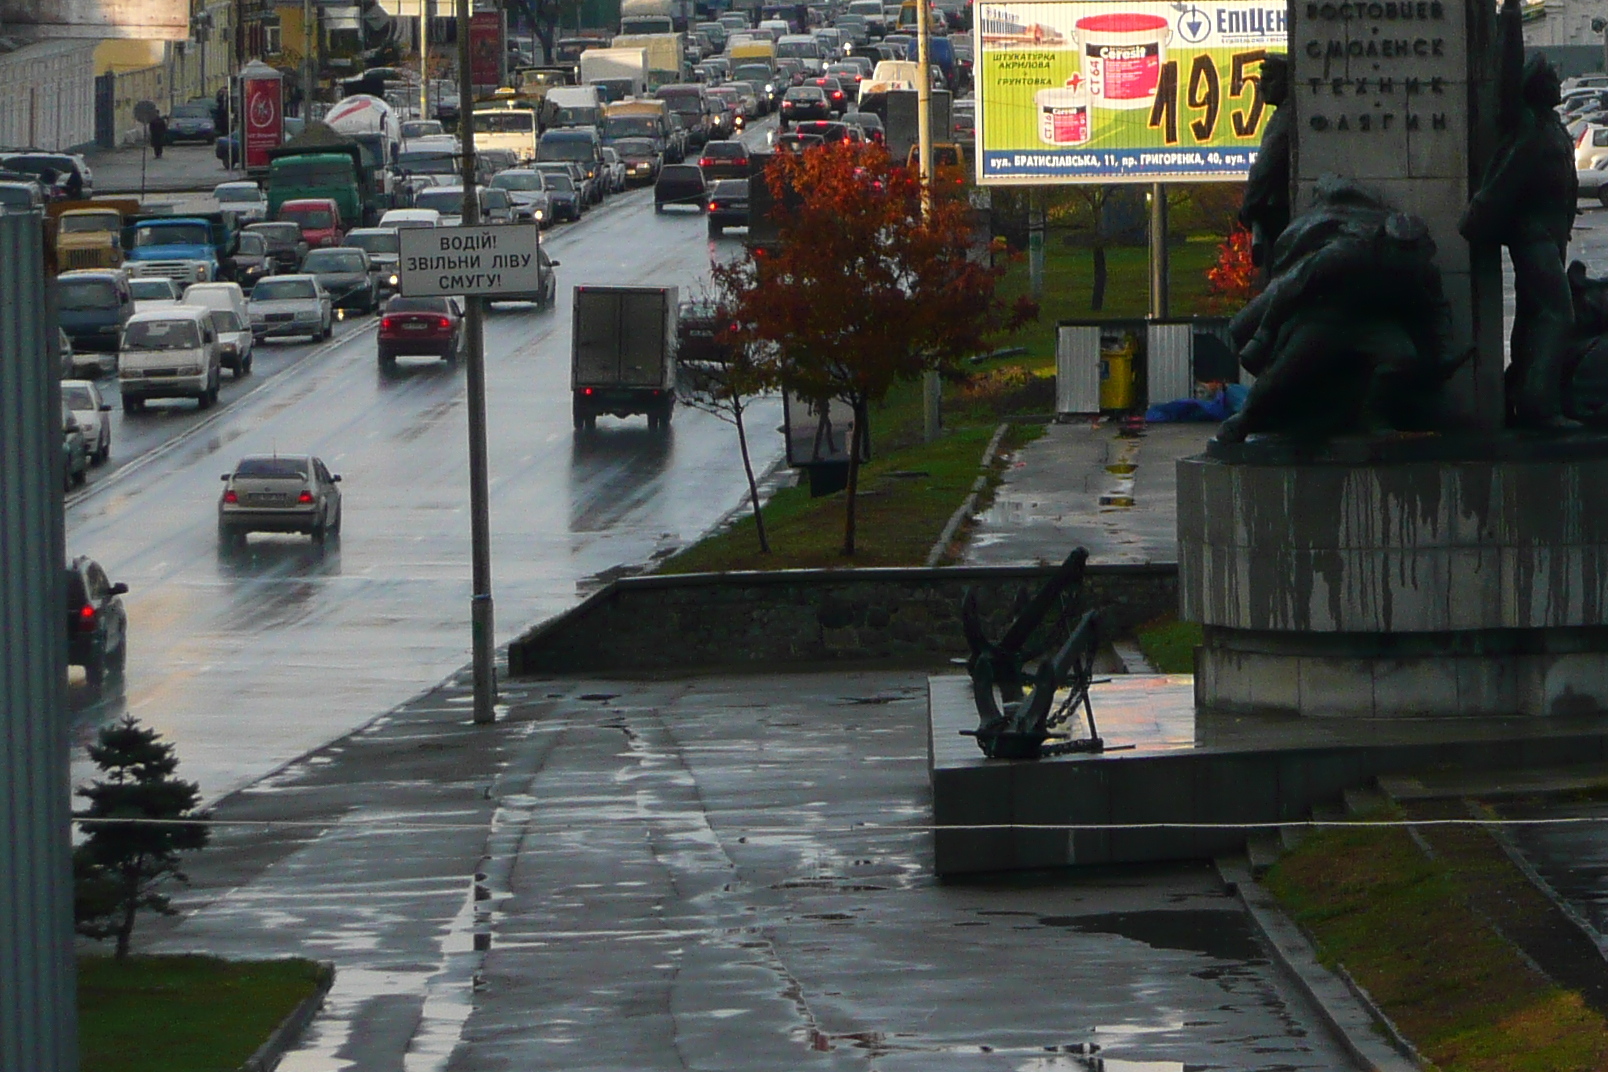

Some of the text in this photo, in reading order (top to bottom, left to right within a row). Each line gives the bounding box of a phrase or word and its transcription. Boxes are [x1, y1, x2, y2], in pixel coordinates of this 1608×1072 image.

[1306, 0, 1444, 20] РОСТОВЦЕВ
[1099, 45, 1146, 60] Ceresit
[1306, 38, 1444, 58] СМОЛЕНСК
[993, 53, 1056, 61] ШТУКАТУРКА
[998, 61, 1051, 70] АКРИЛОВА
[1090, 60, 1100, 77] 64
[997, 78, 1052, 86] ГРУНТОВКА
[1308, 76, 1444, 95] ТЕХНИК
[1147, 49, 1267, 145] 195
[1309, 112, 1446, 131] ФЛЯГИН
[990, 157, 1012, 168] вул.
[1014, 155, 1101, 168] БРАТИСЛАВСЬКА,
[1103, 155, 1119, 167] 11,
[1122, 155, 1137, 169] пр.
[1140, 153, 1205, 166] ГРИГОРЕНКА,
[1207, 153, 1222, 166] 40,
[1225, 154, 1246, 165] вул.
[440, 232, 497, 251] ВОДІЙ!
[407, 253, 531, 271] ЗВІЛЬНИ ЛІВУ
[439, 274, 501, 290] СМУГУ!
